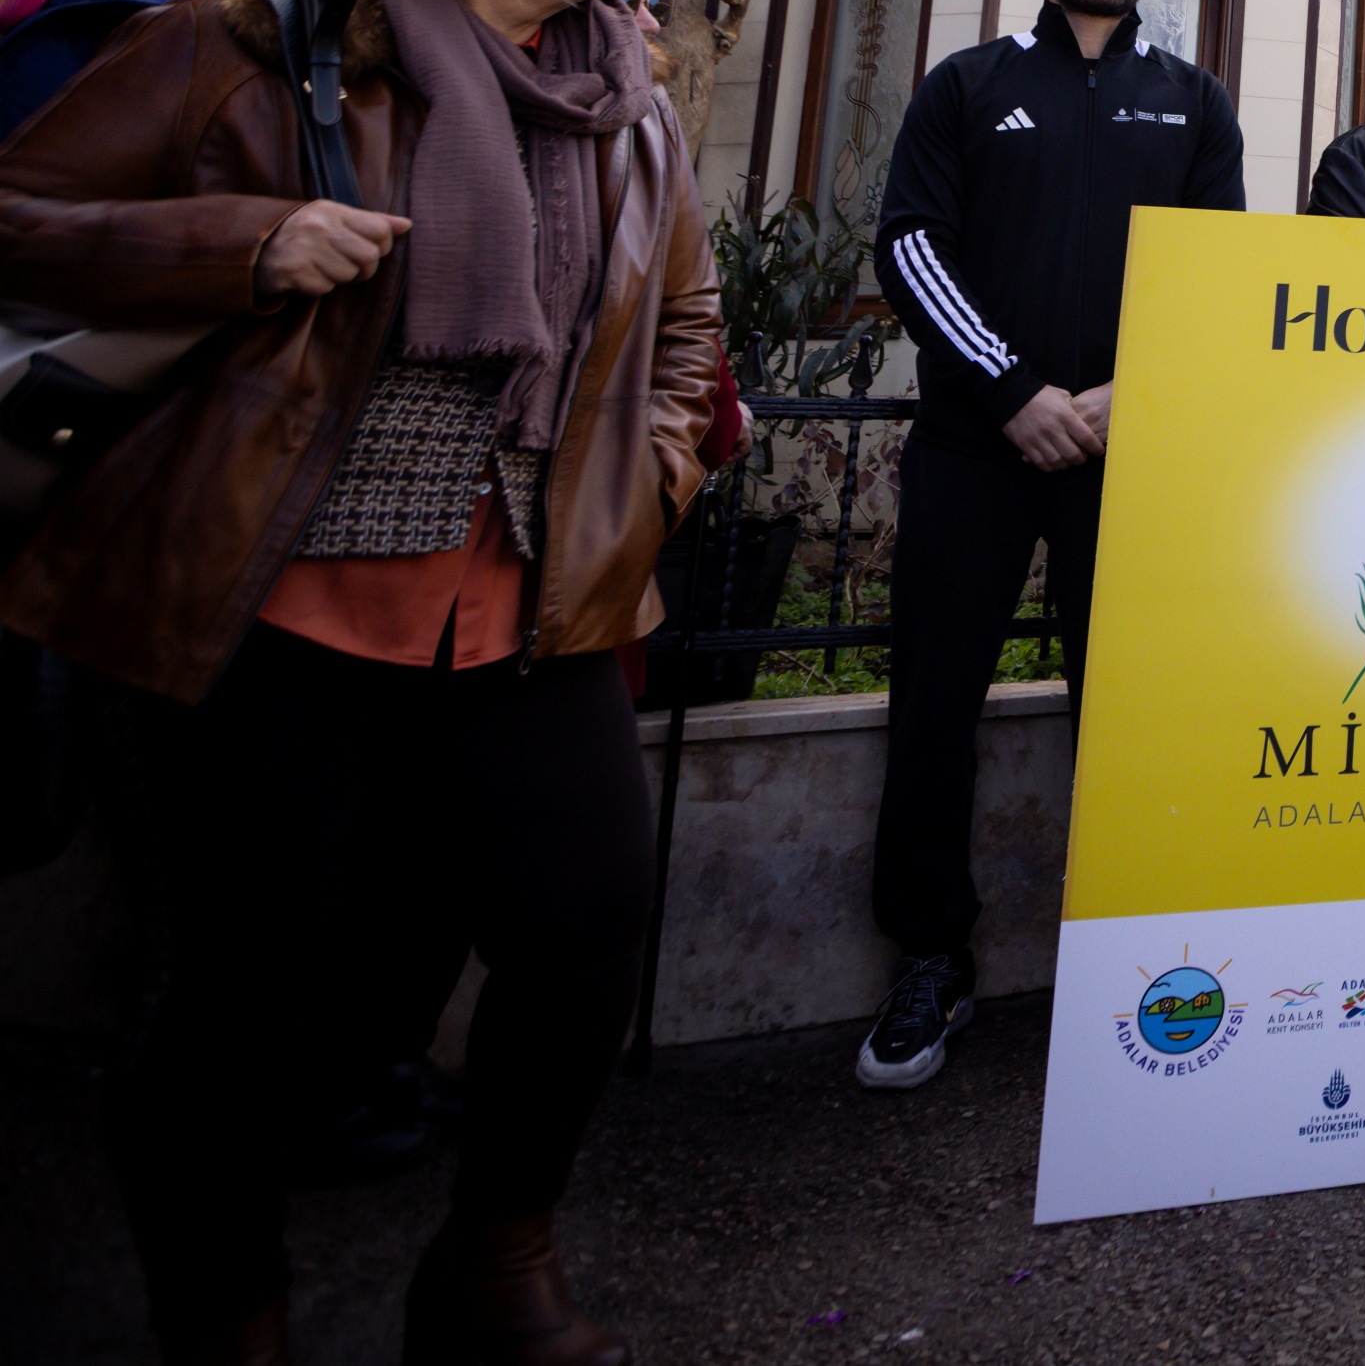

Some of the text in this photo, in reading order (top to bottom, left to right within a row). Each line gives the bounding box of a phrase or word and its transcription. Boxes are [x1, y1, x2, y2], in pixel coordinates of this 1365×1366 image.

[1268, 1010, 1323, 1025] ADALAR
[1267, 1021, 1323, 1034] KENT KONSEYİ
[1339, 1020, 1361, 1029] KÜLTÜR
[1116, 1009, 1246, 1077] ADALAR BELEDİYESİ
[1311, 1112, 1359, 1124] İSTANBUL
[1309, 1131, 1359, 1144] BELEDİYESİ
